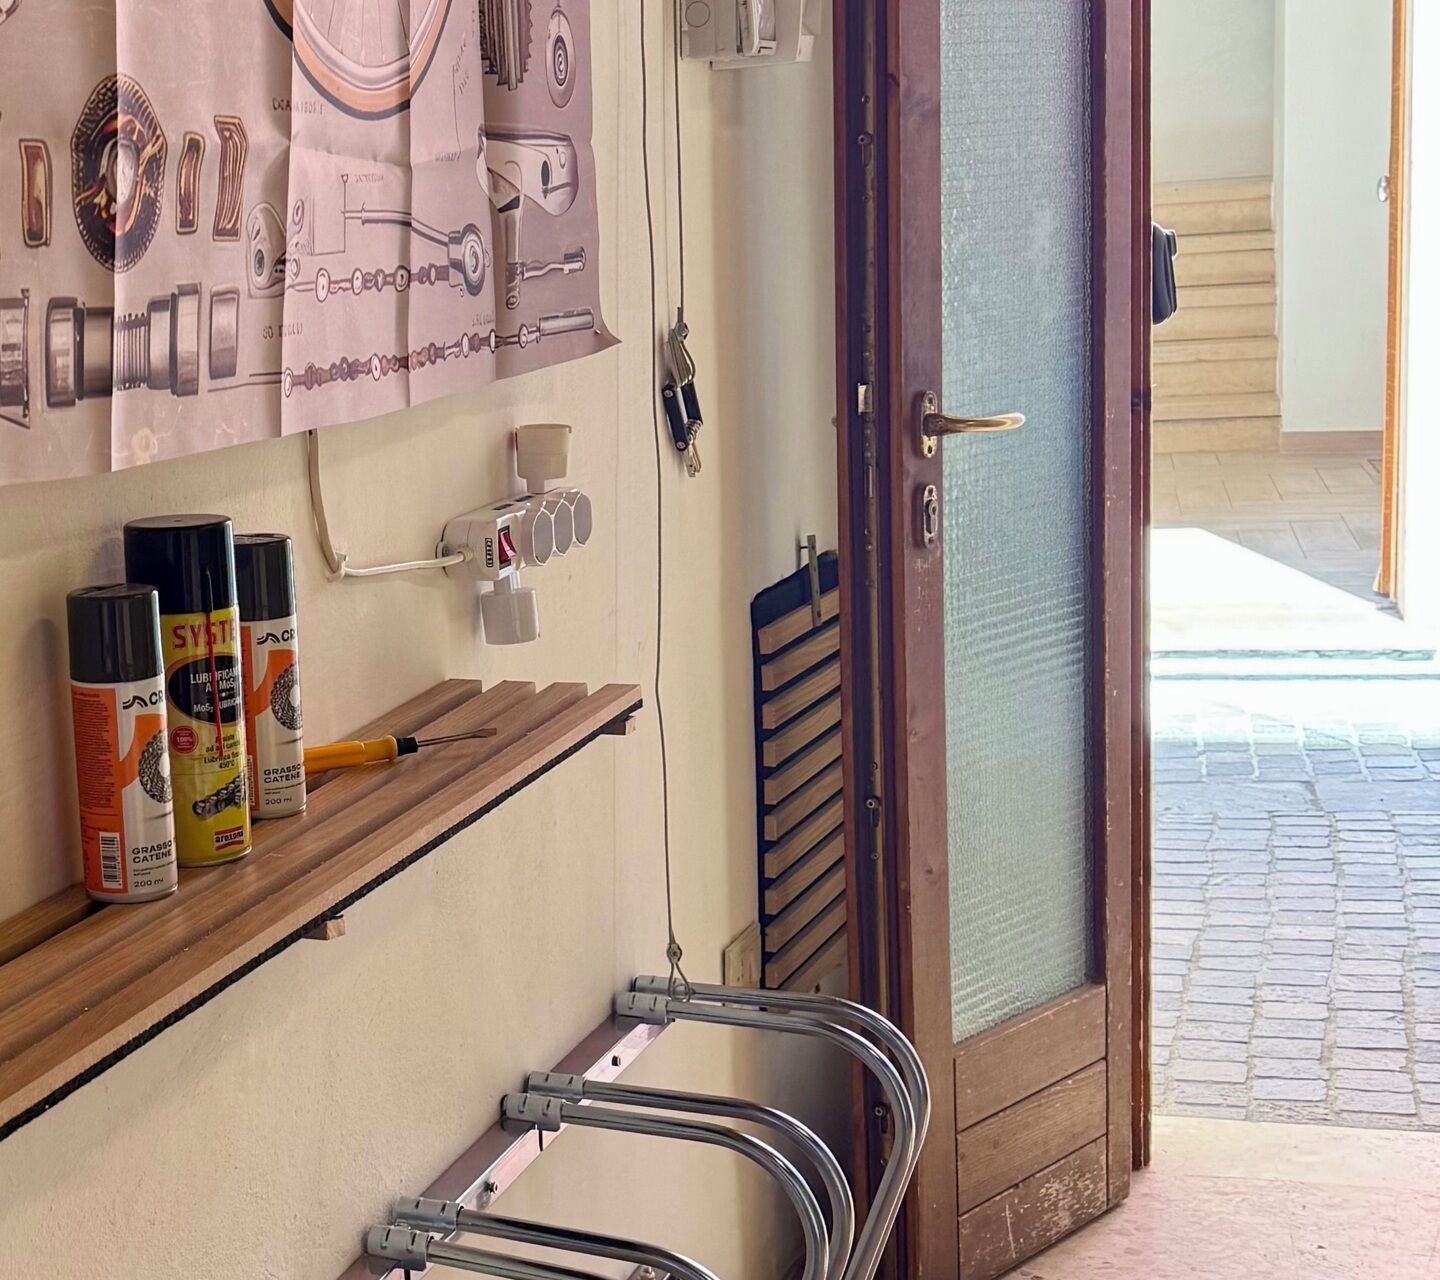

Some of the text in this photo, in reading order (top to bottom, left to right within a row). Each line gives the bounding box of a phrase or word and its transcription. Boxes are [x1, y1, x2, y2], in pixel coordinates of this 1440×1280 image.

[264, 763, 301, 776] GRASSO
[264, 771, 301, 784] CATENE
[132, 840, 172, 855] GRASSO
[132, 849, 172, 864] CATENE
[134, 880, 152, 888] 200
